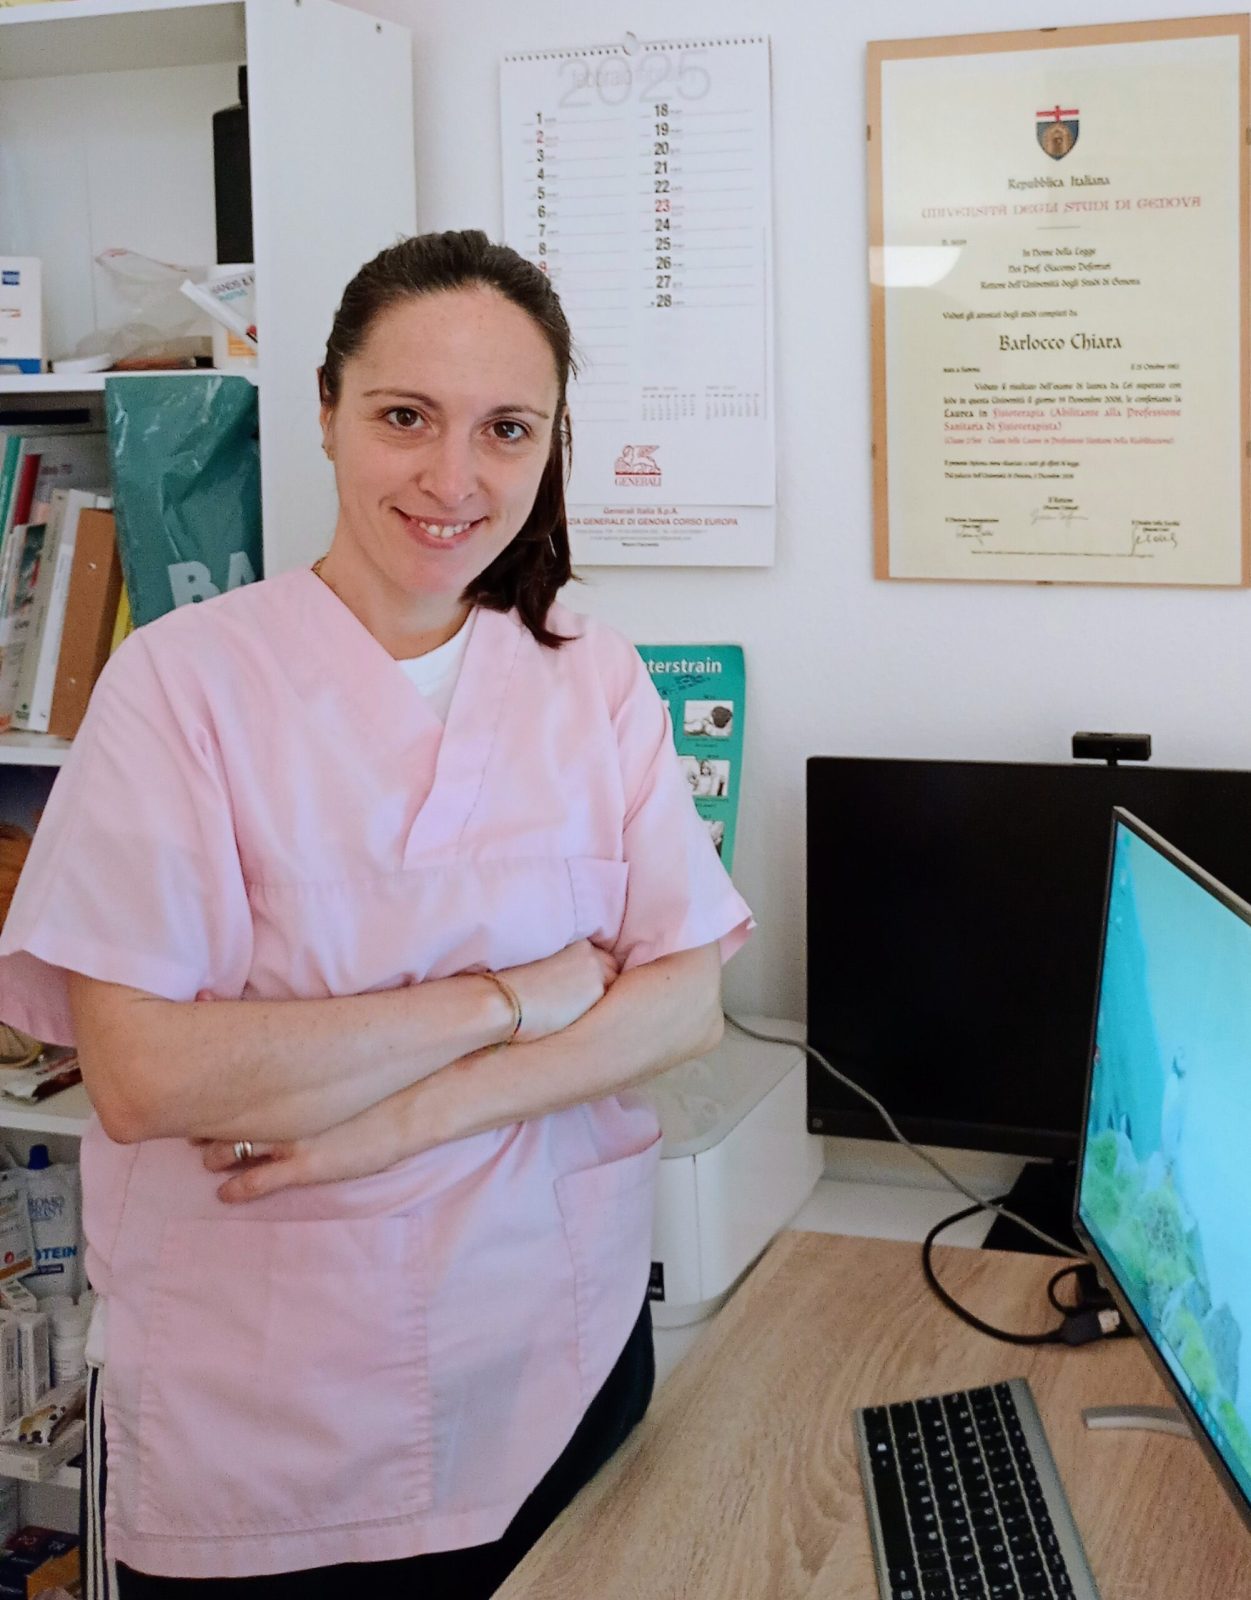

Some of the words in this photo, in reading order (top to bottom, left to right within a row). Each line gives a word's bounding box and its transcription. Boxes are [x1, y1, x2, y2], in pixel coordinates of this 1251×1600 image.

[557, 50, 711, 109] 2025
[654, 104, 669, 117] 18
[536, 112, 543, 124] 1
[655, 123, 669, 136] 19
[536, 131, 544, 143] 2
[654, 142, 669, 155] 20
[537, 150, 544, 162] 3
[655, 161, 668, 174] 21
[537, 168, 545, 181] 4
[655, 180, 670, 193] 22
[1007, 177, 1064, 191] Repubblica
[1070, 174, 1111, 187] Italiana
[537, 187, 545, 199] 5
[538, 205, 545, 218] 6
[655, 199, 671, 212] 23
[1013, 202, 1059, 215] DEGLI
[1063, 200, 1109, 214] STUDI
[1114, 198, 1131, 211] DI
[538, 224, 546, 236] 7
[655, 218, 670, 231] 24
[539, 243, 546, 255] 8
[656, 237, 671, 250] 25
[656, 257, 671, 270] 26
[656, 276, 671, 288] 27
[657, 295, 672, 307] 28
[999, 333, 1065, 351] Barlocco
[1070, 332, 1122, 350] Chiara
[944, 407, 974, 418] Laurea
[978, 409, 988, 418] in
[615, 477, 662, 487] GENERALI
[603, 507, 634, 515] Generali
[673, 518, 702, 526] CORSO
[704, 518, 738, 526] EUROPA
[645, 657, 722, 674] terstrain
[37, 1245, 78, 1260] TEIN
